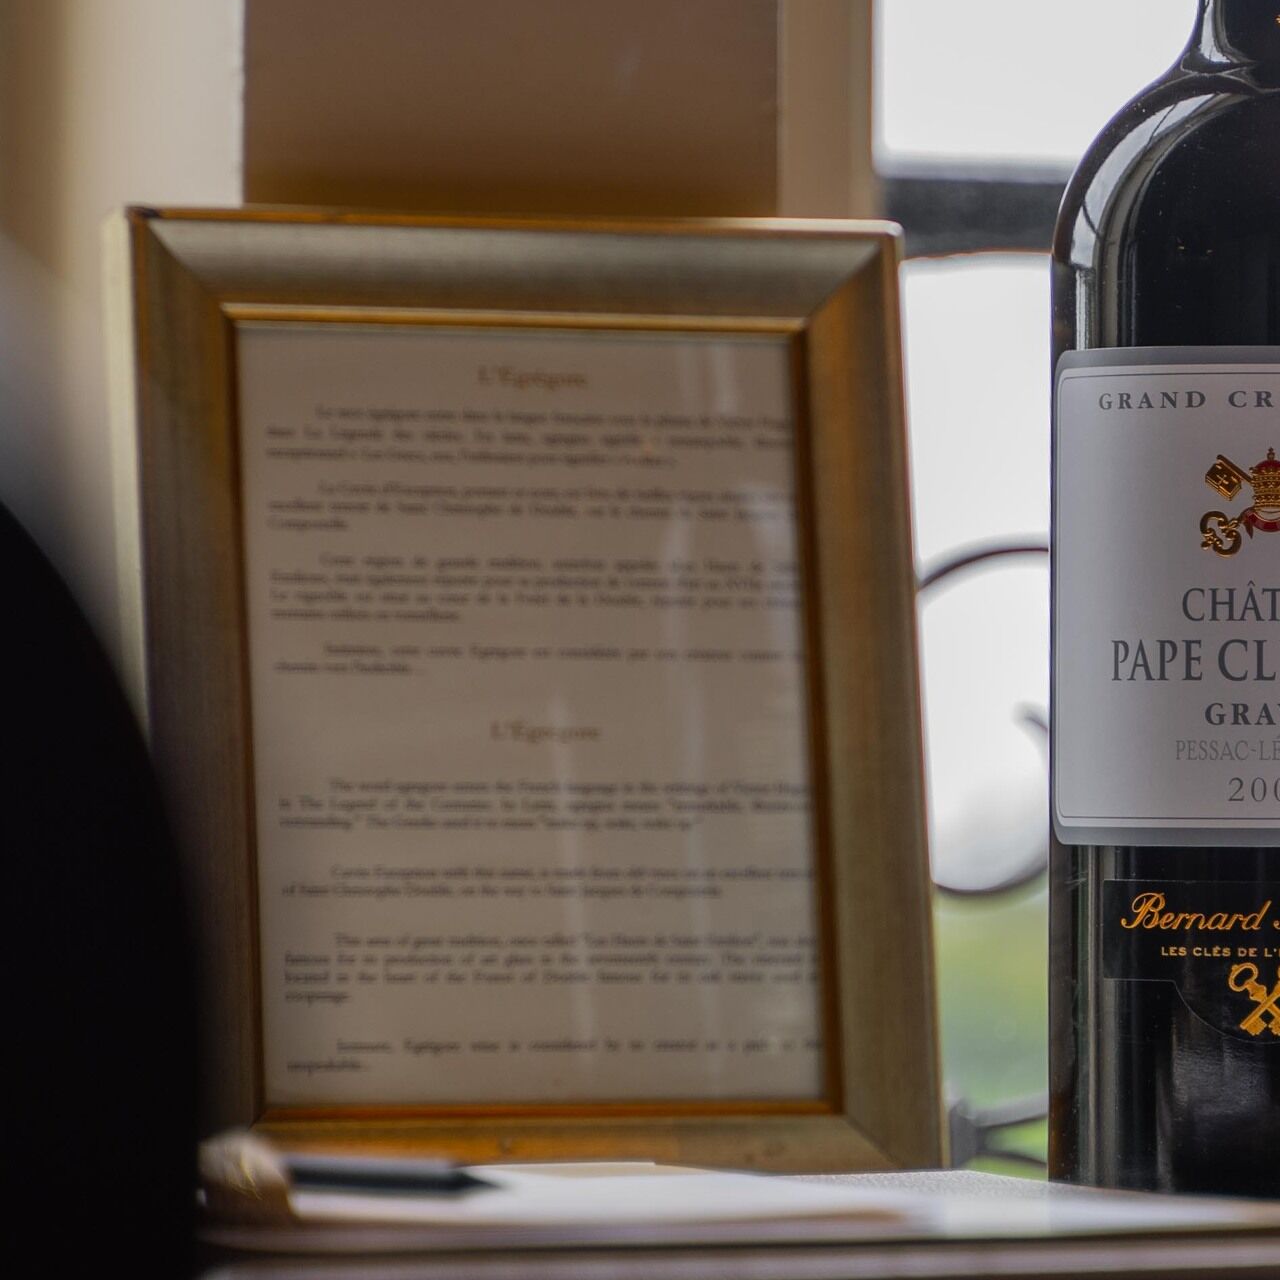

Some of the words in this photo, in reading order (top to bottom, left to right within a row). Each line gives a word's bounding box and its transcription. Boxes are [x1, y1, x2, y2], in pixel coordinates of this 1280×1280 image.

[1098, 391, 1206, 411] GRAND
[1111, 638, 1203, 682] PAPE
[1121, 892, 1271, 931] Bernard
[1161, 946, 1187, 957] LES
[1192, 944, 1231, 958] CLÉS
[1237, 947, 1258, 958] DE
